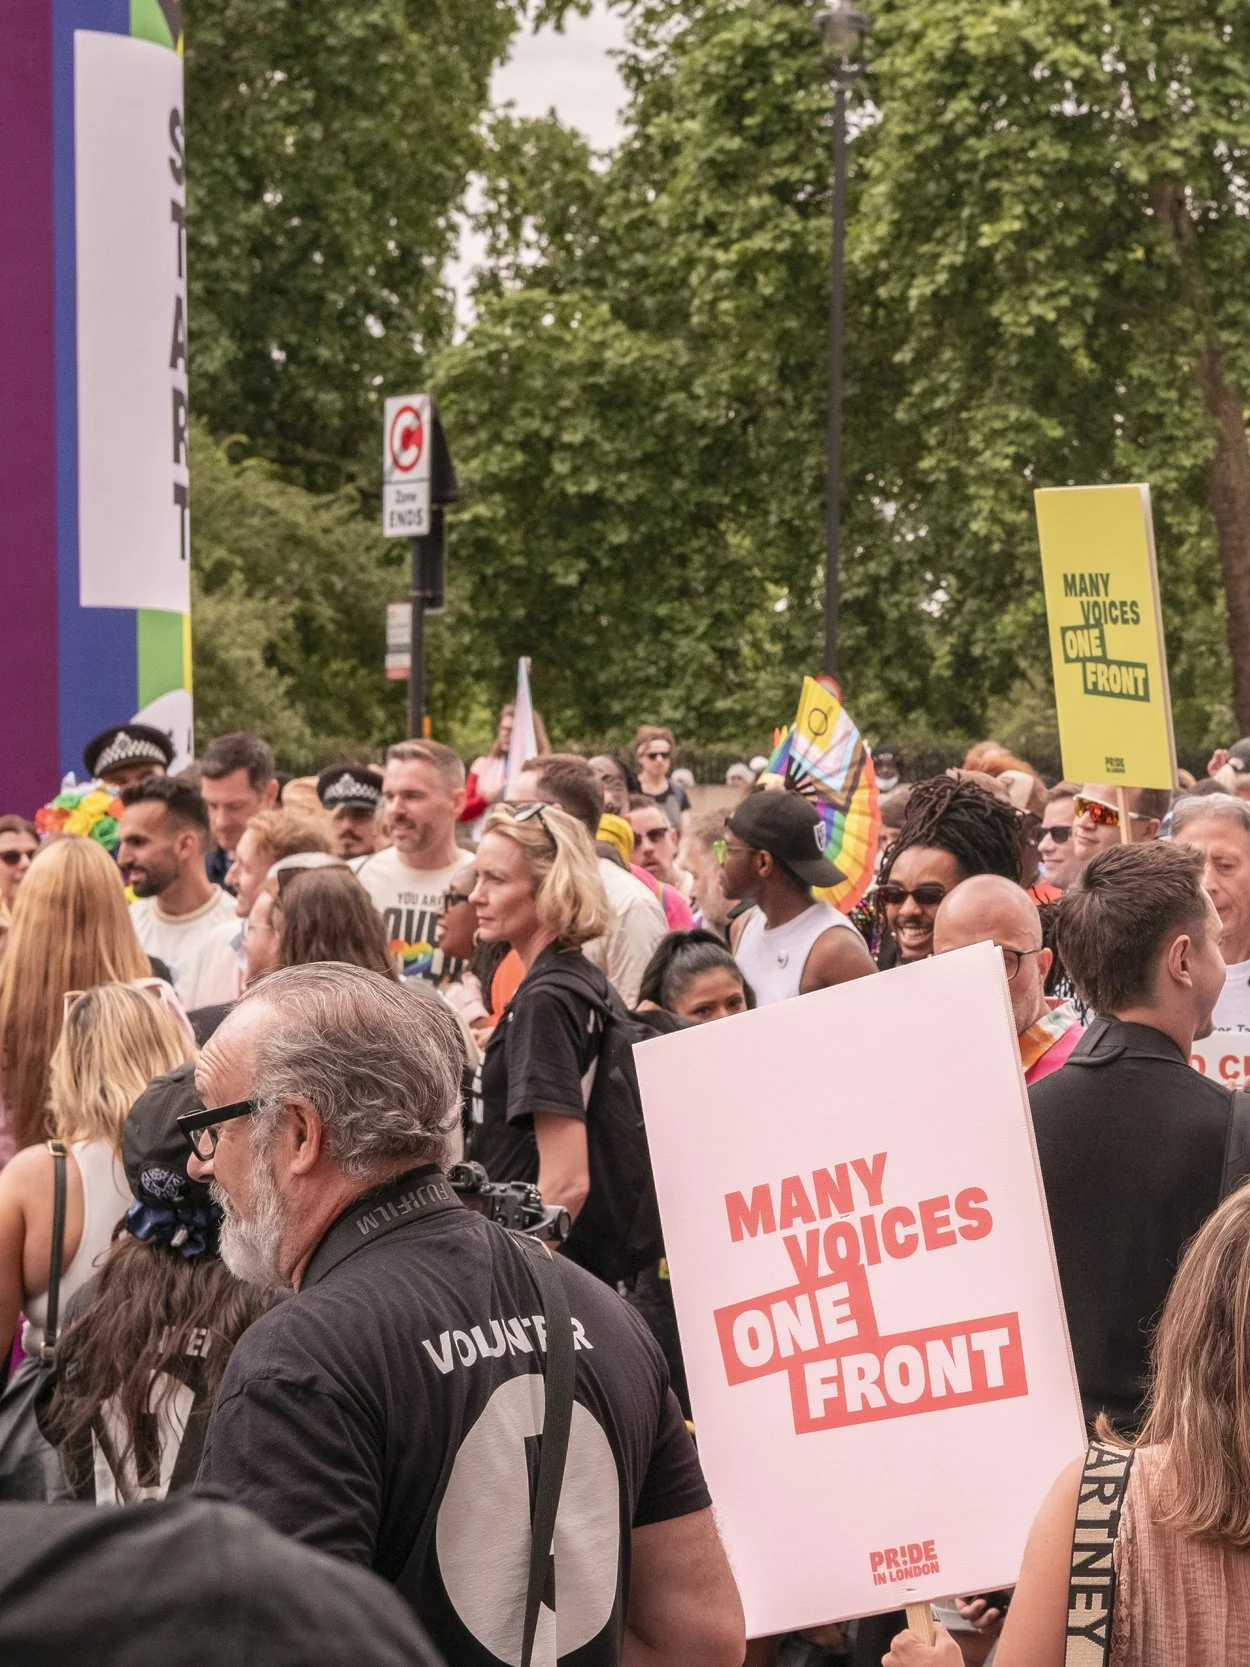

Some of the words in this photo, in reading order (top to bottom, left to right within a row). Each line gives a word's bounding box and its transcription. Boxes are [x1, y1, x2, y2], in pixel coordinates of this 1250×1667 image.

[168, 107, 188, 560] START
[390, 509, 423, 528] ENDS
[1063, 573, 1110, 597] MANY
[1081, 600, 1140, 625] VOICES
[1065, 628, 1102, 659] ONE
[1085, 662, 1146, 696] FRONT
[398, 893, 419, 904] YOU
[356, 1182, 450, 1236] FUJIFILM
[724, 1152, 888, 1243] MANY
[782, 1186, 994, 1286] VOICES
[732, 1281, 859, 1368] ONE
[803, 1327, 1011, 1420] FRONT
[1067, 1441, 1128, 1648] ARTNEY
[873, 1572, 887, 1586] IN
[889, 1561, 940, 1582] LONDON
